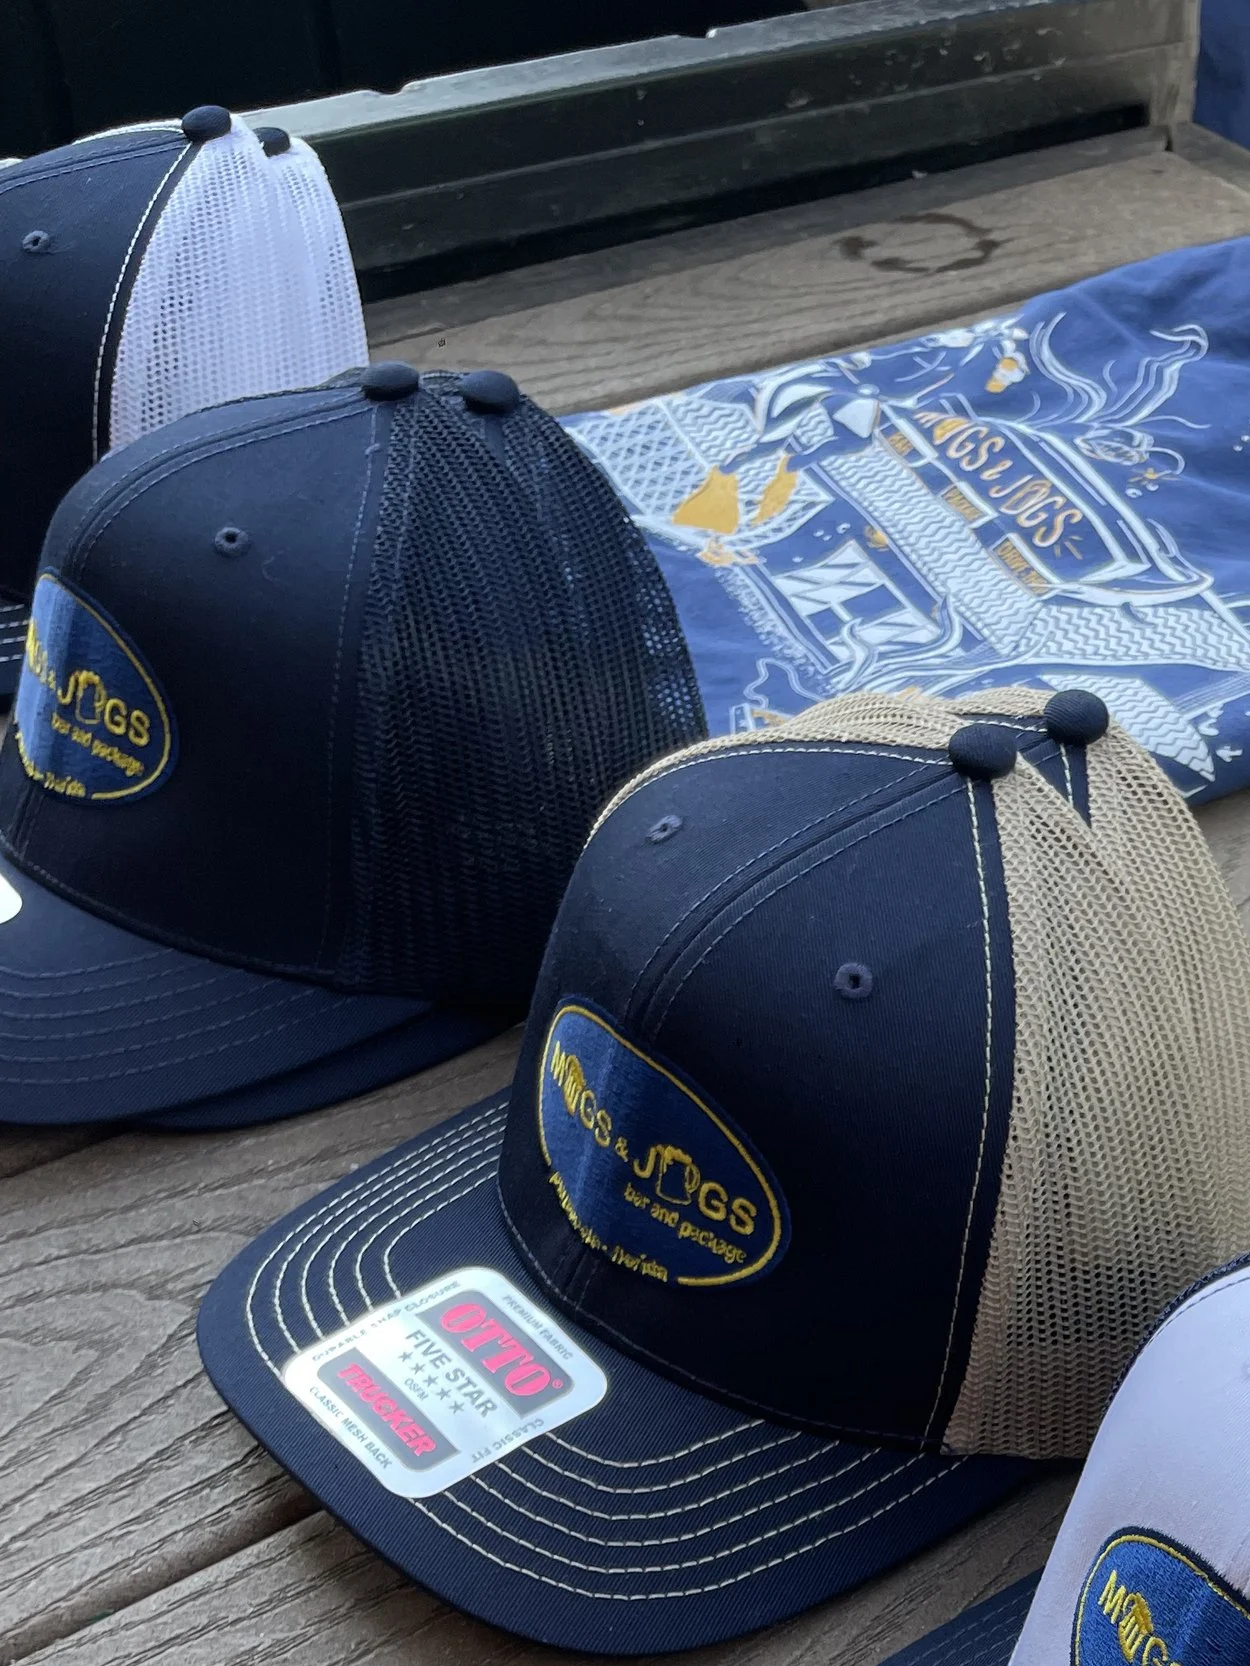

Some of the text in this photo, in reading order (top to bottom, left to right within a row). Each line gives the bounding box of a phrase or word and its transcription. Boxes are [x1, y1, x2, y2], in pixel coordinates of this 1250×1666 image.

[614, 1137, 629, 1163] &
[624, 1182, 747, 1264] bar and package
[405, 1281, 461, 1311] CLOSURE
[502, 1294, 574, 1361] PREMIUM FABRIC
[404, 1377, 429, 1402] OSFM
[405, 1328, 498, 1418] FIVE STAR
[309, 1385, 393, 1470] CLASSIC MESH BACK
[336, 1363, 437, 1457] TRUCKER
[471, 1418, 545, 1464] CLASSIC FIT
